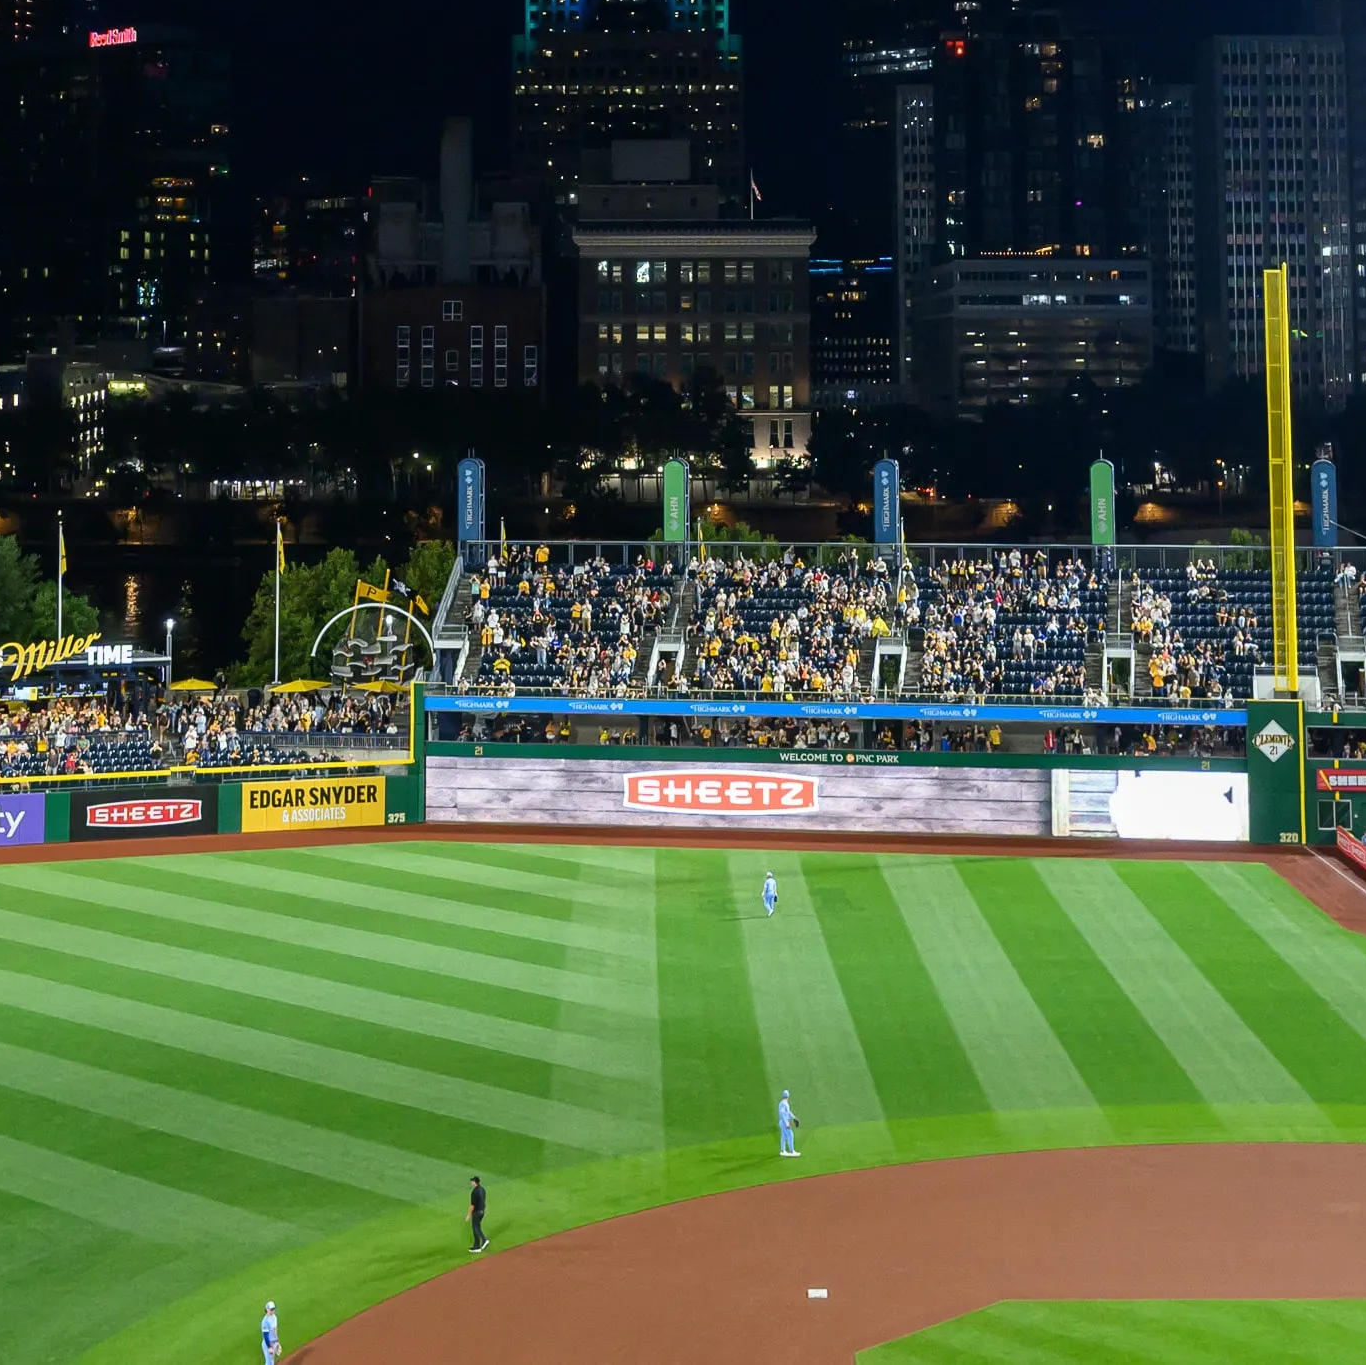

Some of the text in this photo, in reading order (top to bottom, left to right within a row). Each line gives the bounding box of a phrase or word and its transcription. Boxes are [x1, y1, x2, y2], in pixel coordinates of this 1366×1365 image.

[670, 497, 679, 519] AHN
[1097, 498, 1107, 521] AHN
[86, 645, 133, 665] TIME
[455, 700, 494, 709] HIGHMARK
[569, 702, 609, 711] HIGHMARK
[690, 704, 731, 713] HIGHMARK
[801, 706, 843, 715] HIGHMARK
[920, 708, 961, 717] HIGHMARK
[1039, 710, 1081, 719] HIGHMARK
[1158, 712, 1201, 721] HIGHMARK
[1252, 734, 1293, 749] CLEMENTE
[1269, 745, 1278, 755] 21
[780, 753, 899, 763] WELCOME TO PNC PARK
[1201, 761, 1210, 770] 21
[249, 785, 377, 809] EDGAR SNYDER
[637, 779, 803, 806] SHEETZ
[95, 804, 193, 822] SHEETZ
[282, 807, 346, 822] & ASSOCIATES
[388, 813, 405, 823] 375
[1280, 833, 1298, 843] 320
